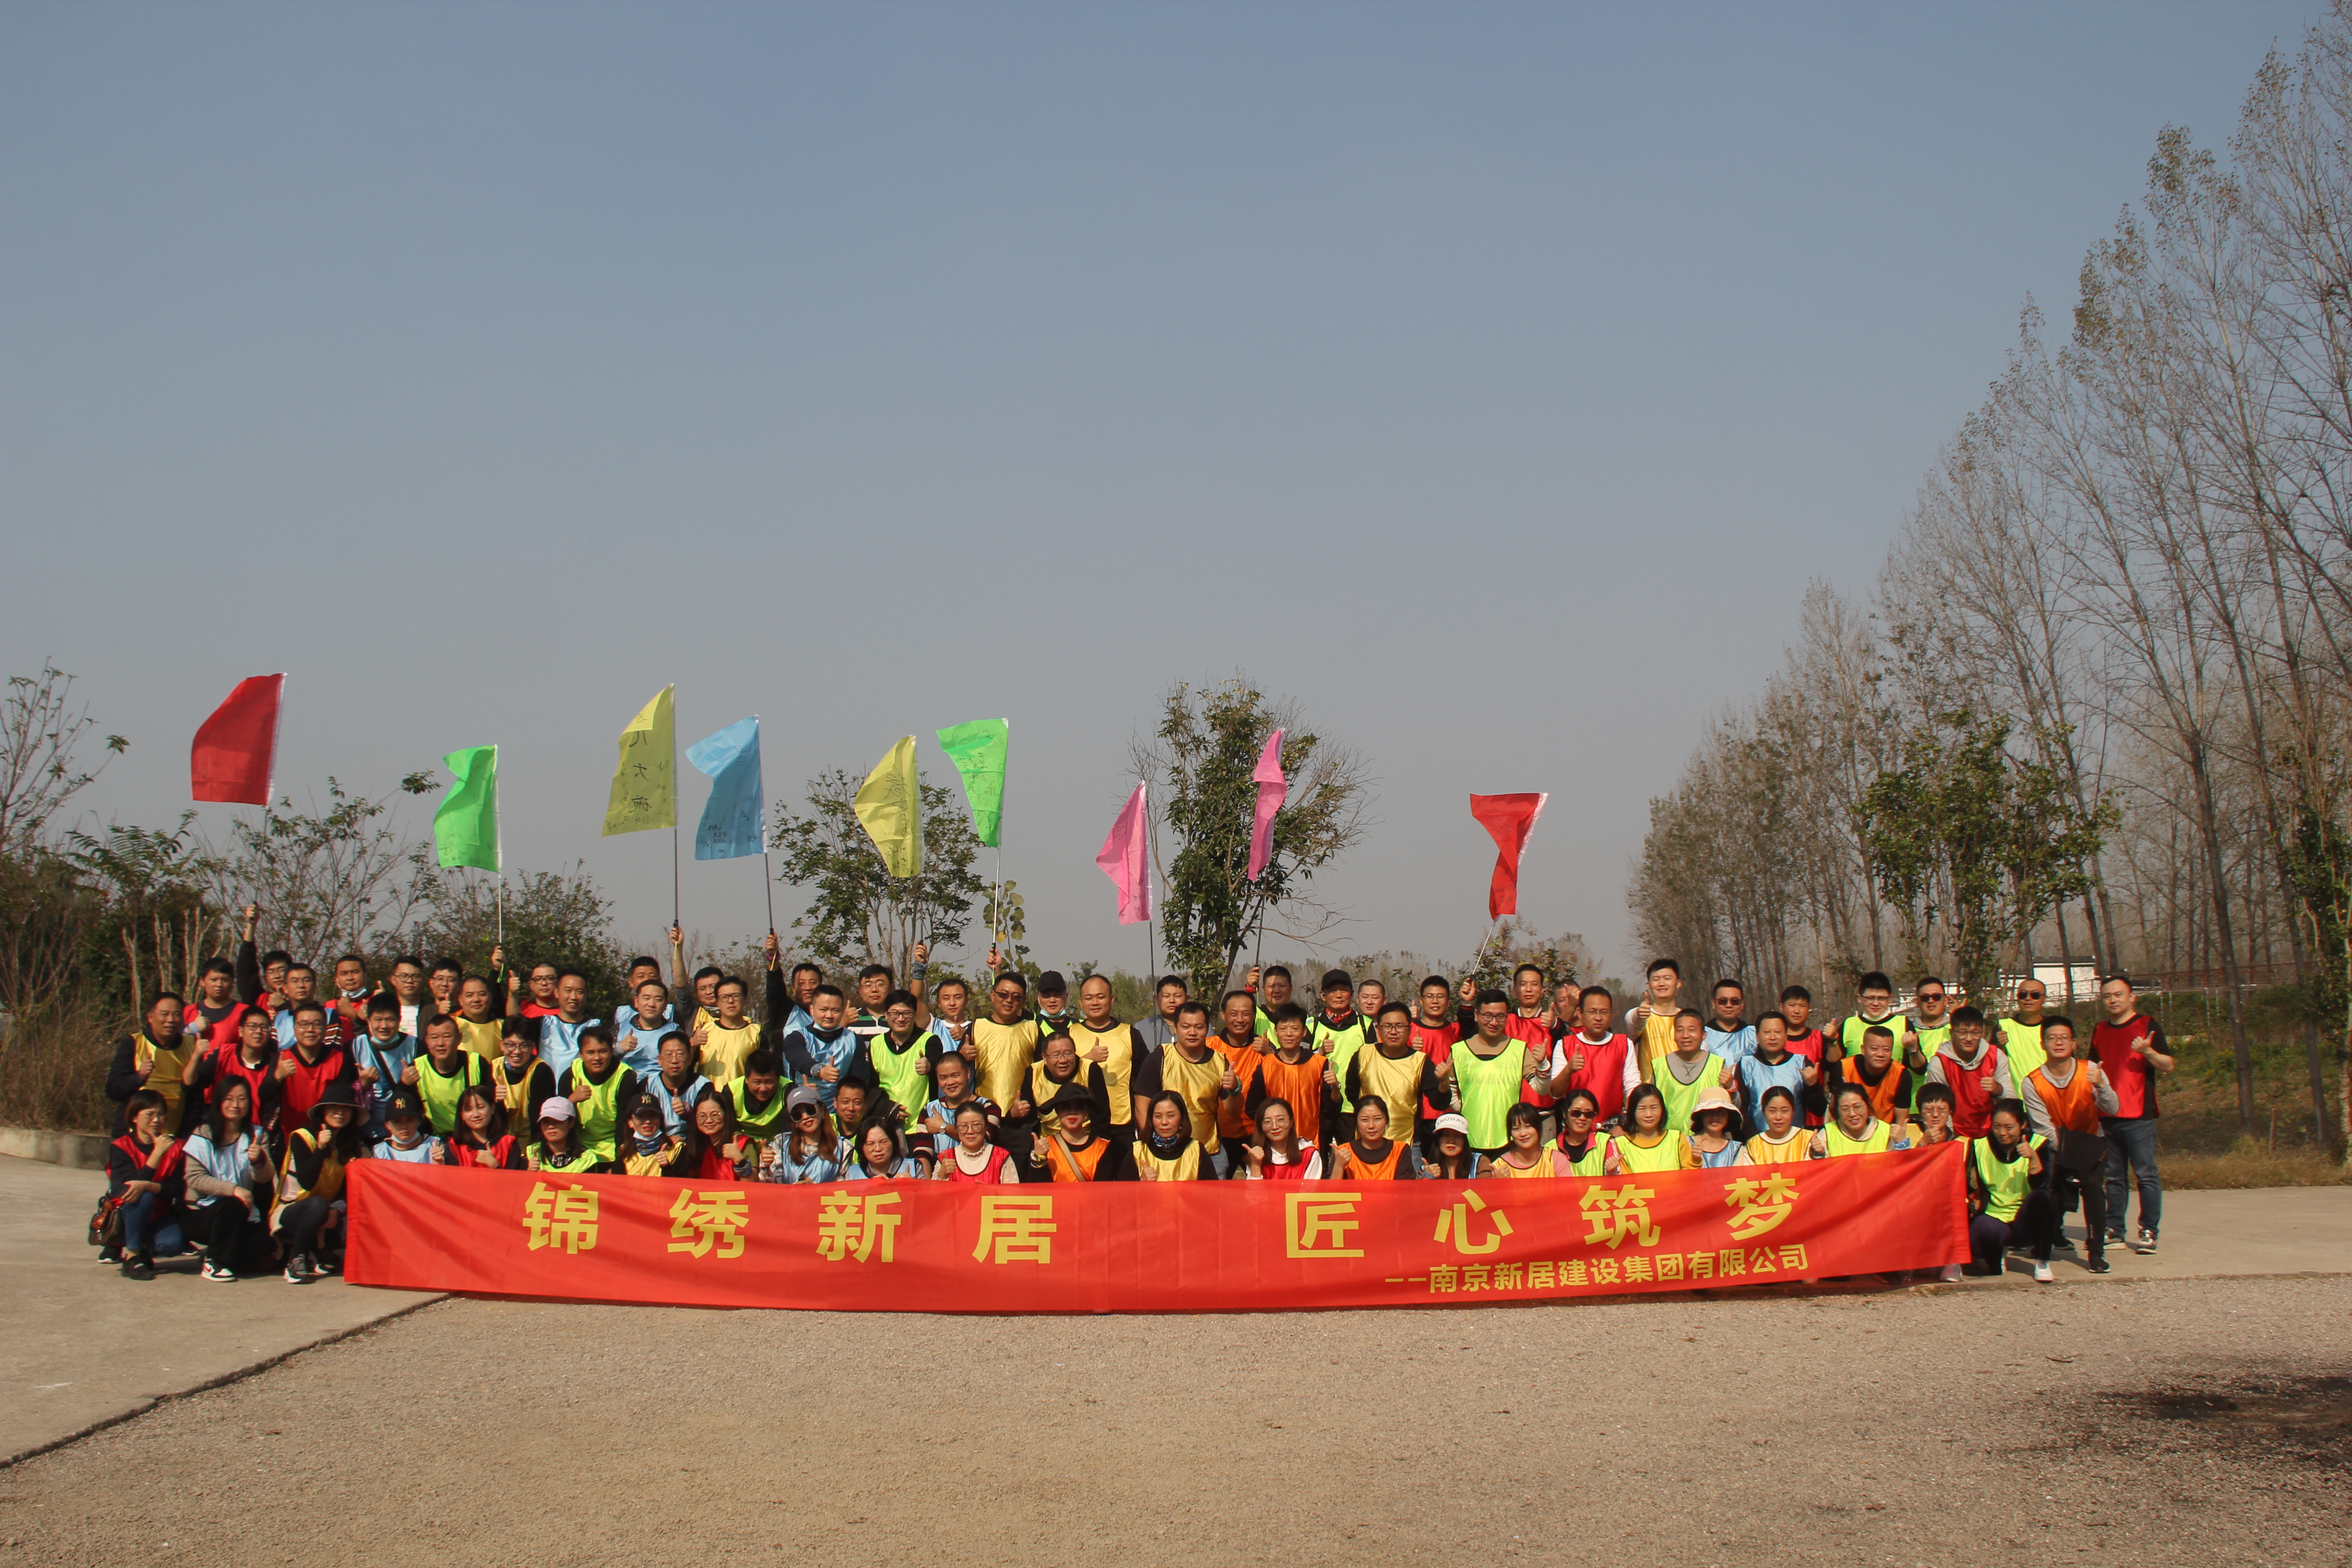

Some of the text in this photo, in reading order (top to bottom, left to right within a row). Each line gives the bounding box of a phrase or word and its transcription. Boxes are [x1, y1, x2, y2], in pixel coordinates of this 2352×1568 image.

[523, 1172, 1799, 1264] 锦绣新居 匠心筑梦
